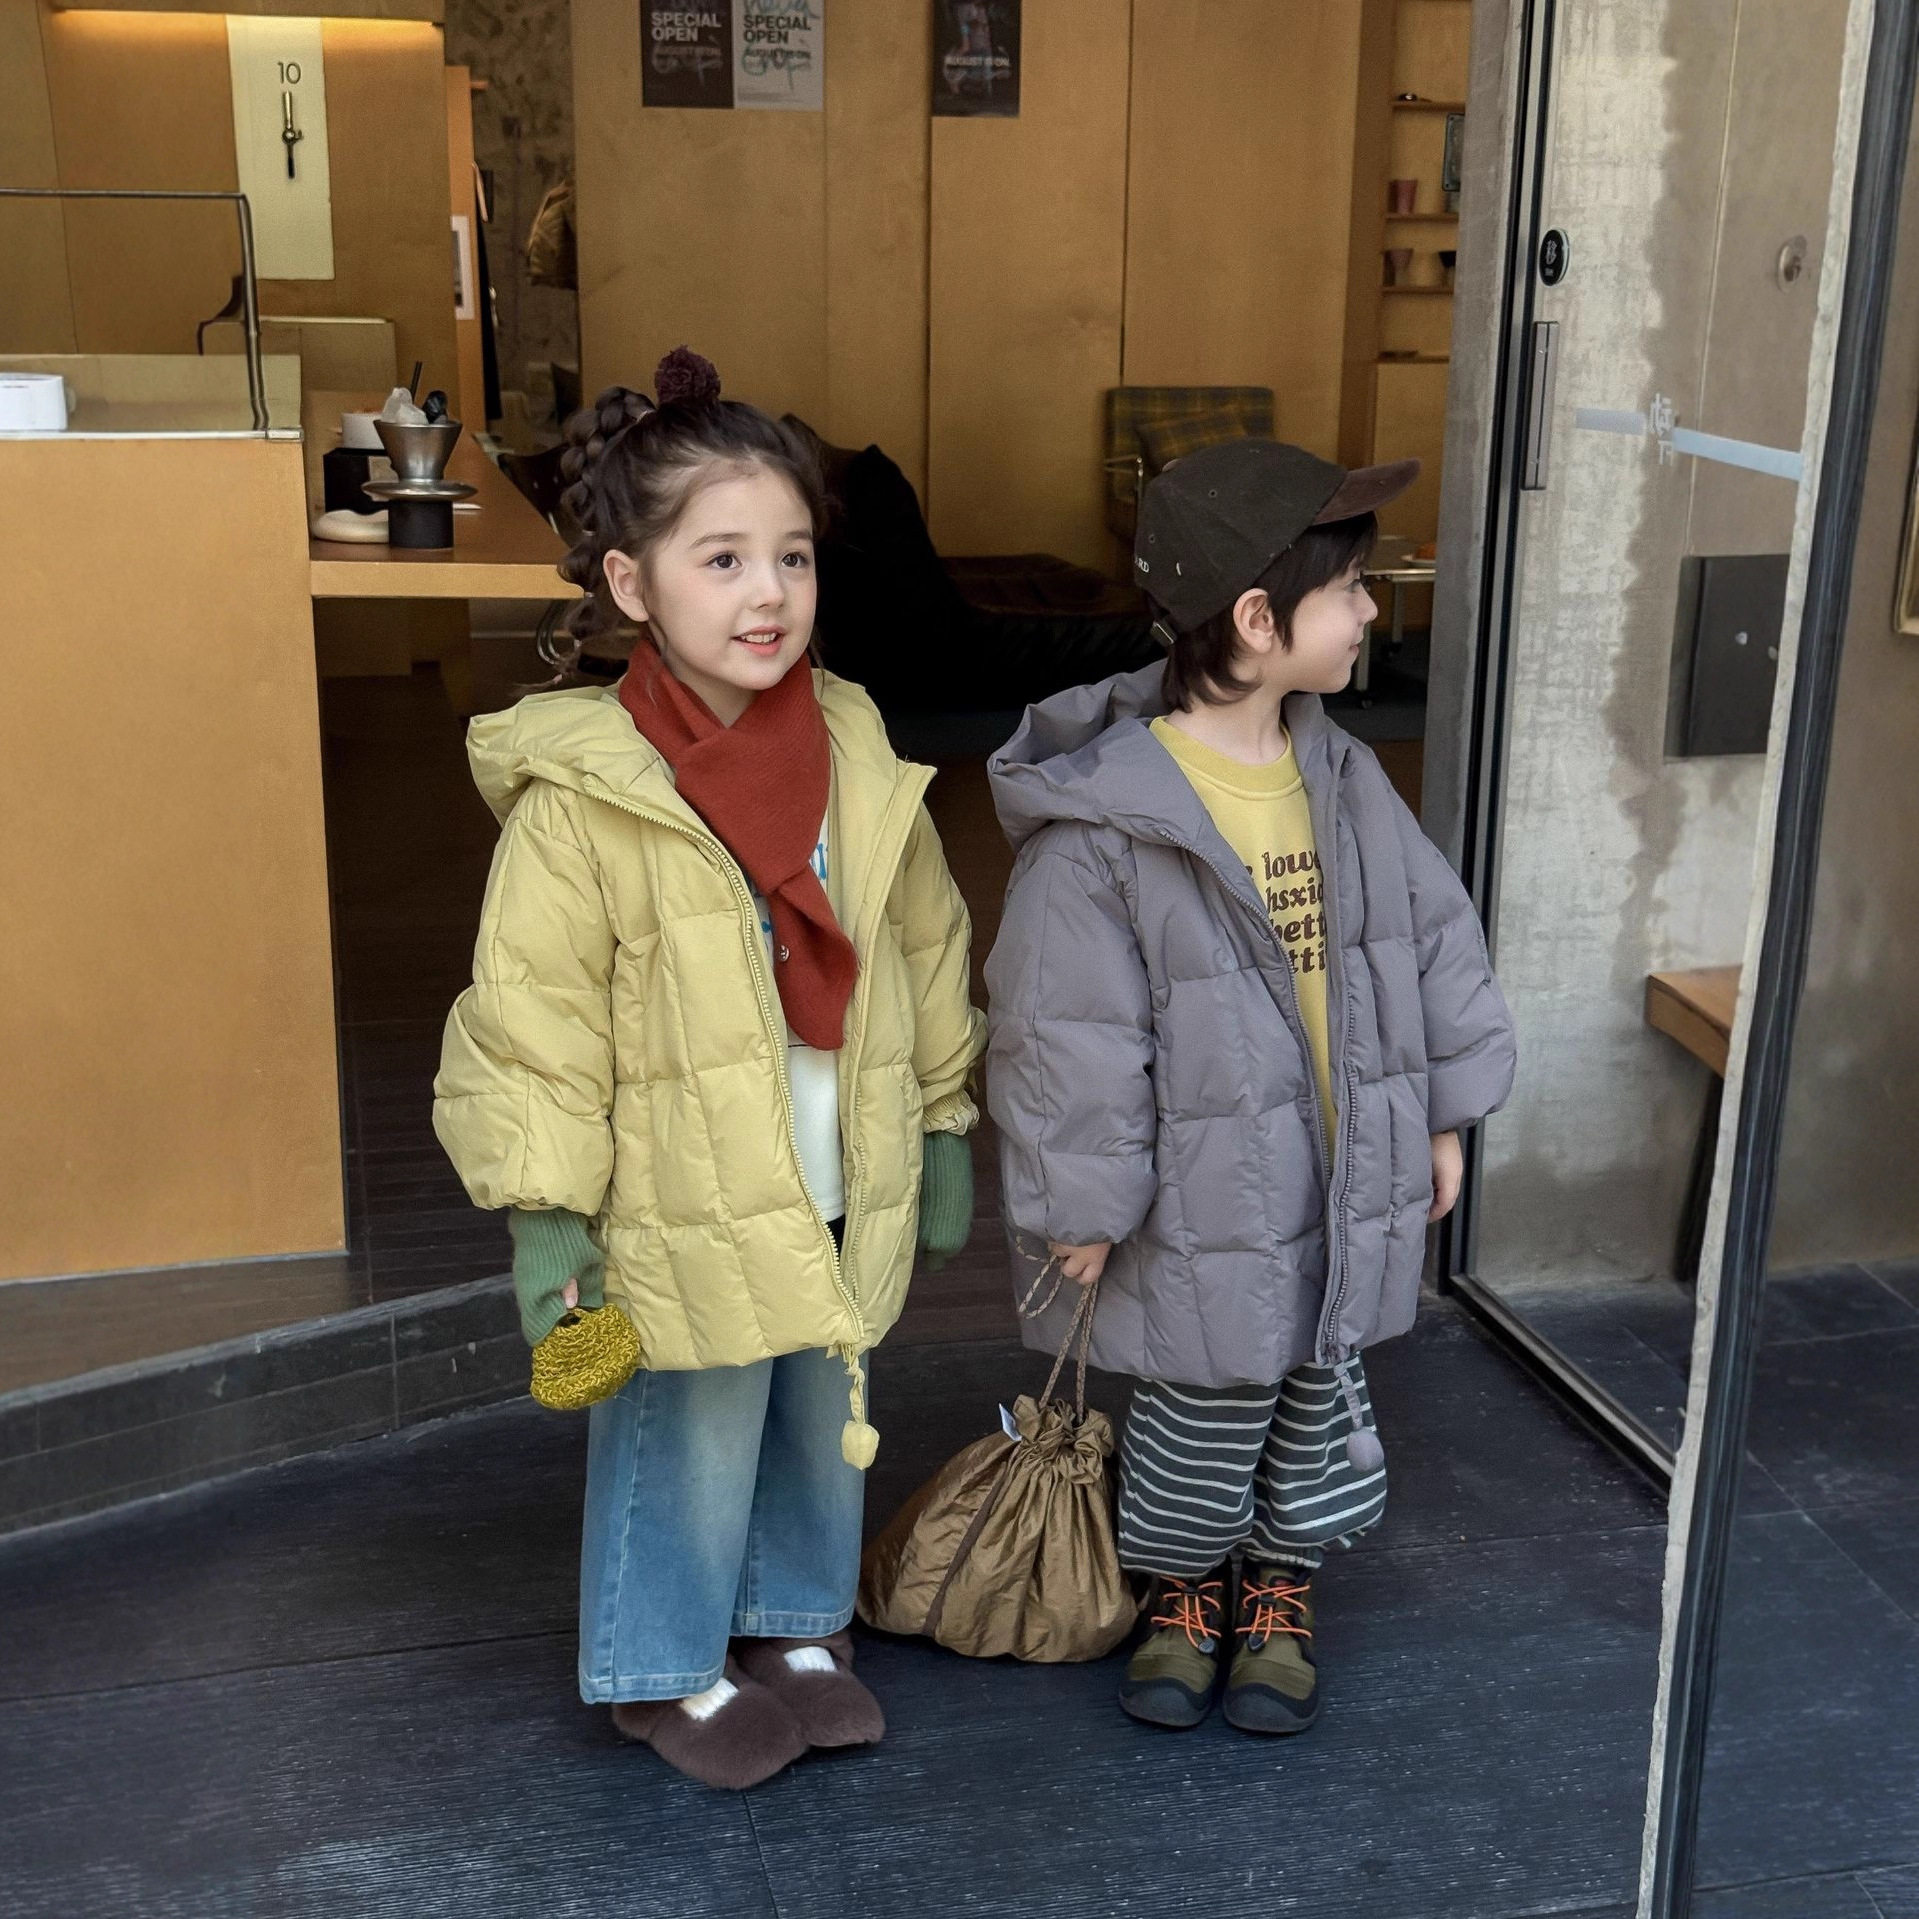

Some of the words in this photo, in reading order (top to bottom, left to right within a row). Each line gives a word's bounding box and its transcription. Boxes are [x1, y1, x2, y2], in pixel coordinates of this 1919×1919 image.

[651, 12, 722, 28] SPECIAL
[743, 14, 812, 31] SPECIAL
[651, 27, 698, 41] OPEN
[743, 30, 789, 44] OPEN
[277, 61, 301, 85] 10
